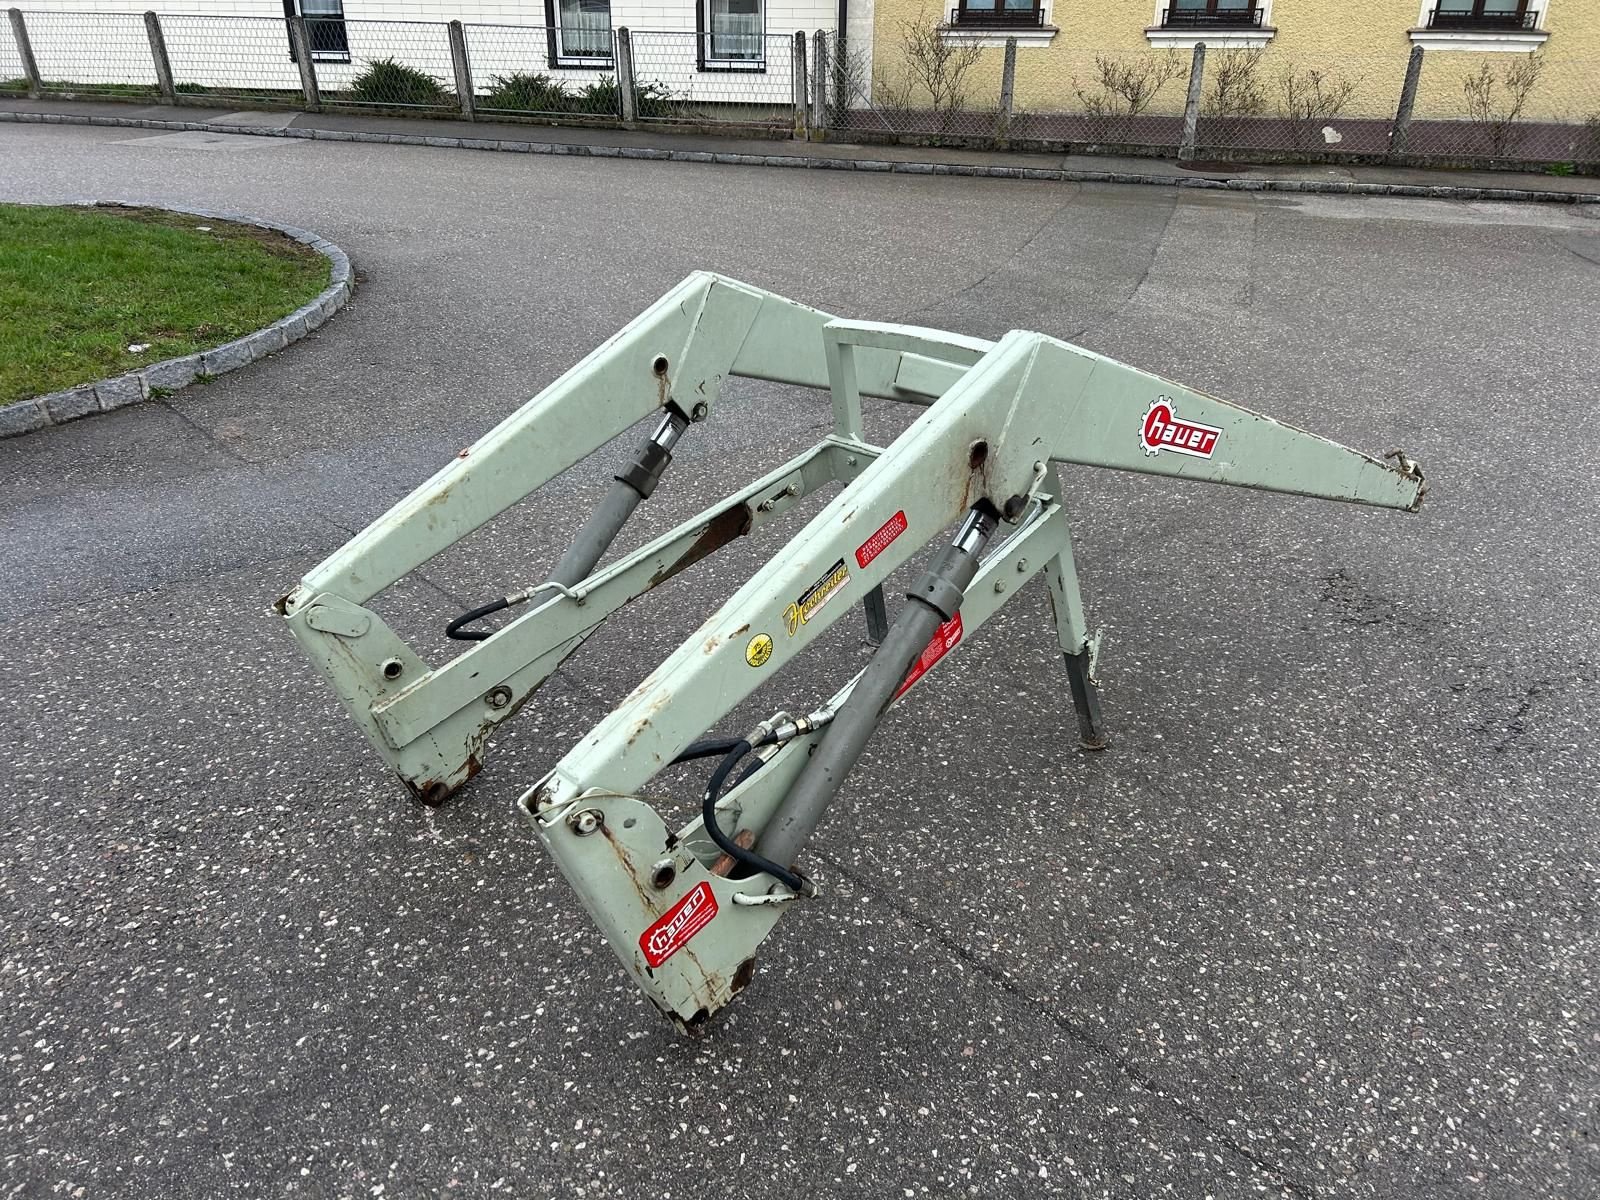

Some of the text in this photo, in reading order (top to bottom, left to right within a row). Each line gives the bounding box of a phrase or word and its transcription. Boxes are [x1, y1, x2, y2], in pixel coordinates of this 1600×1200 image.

[1147, 409, 1216, 449] hauer
[782, 565, 848, 637] Hochreiter
[655, 891, 702, 949] hauer
